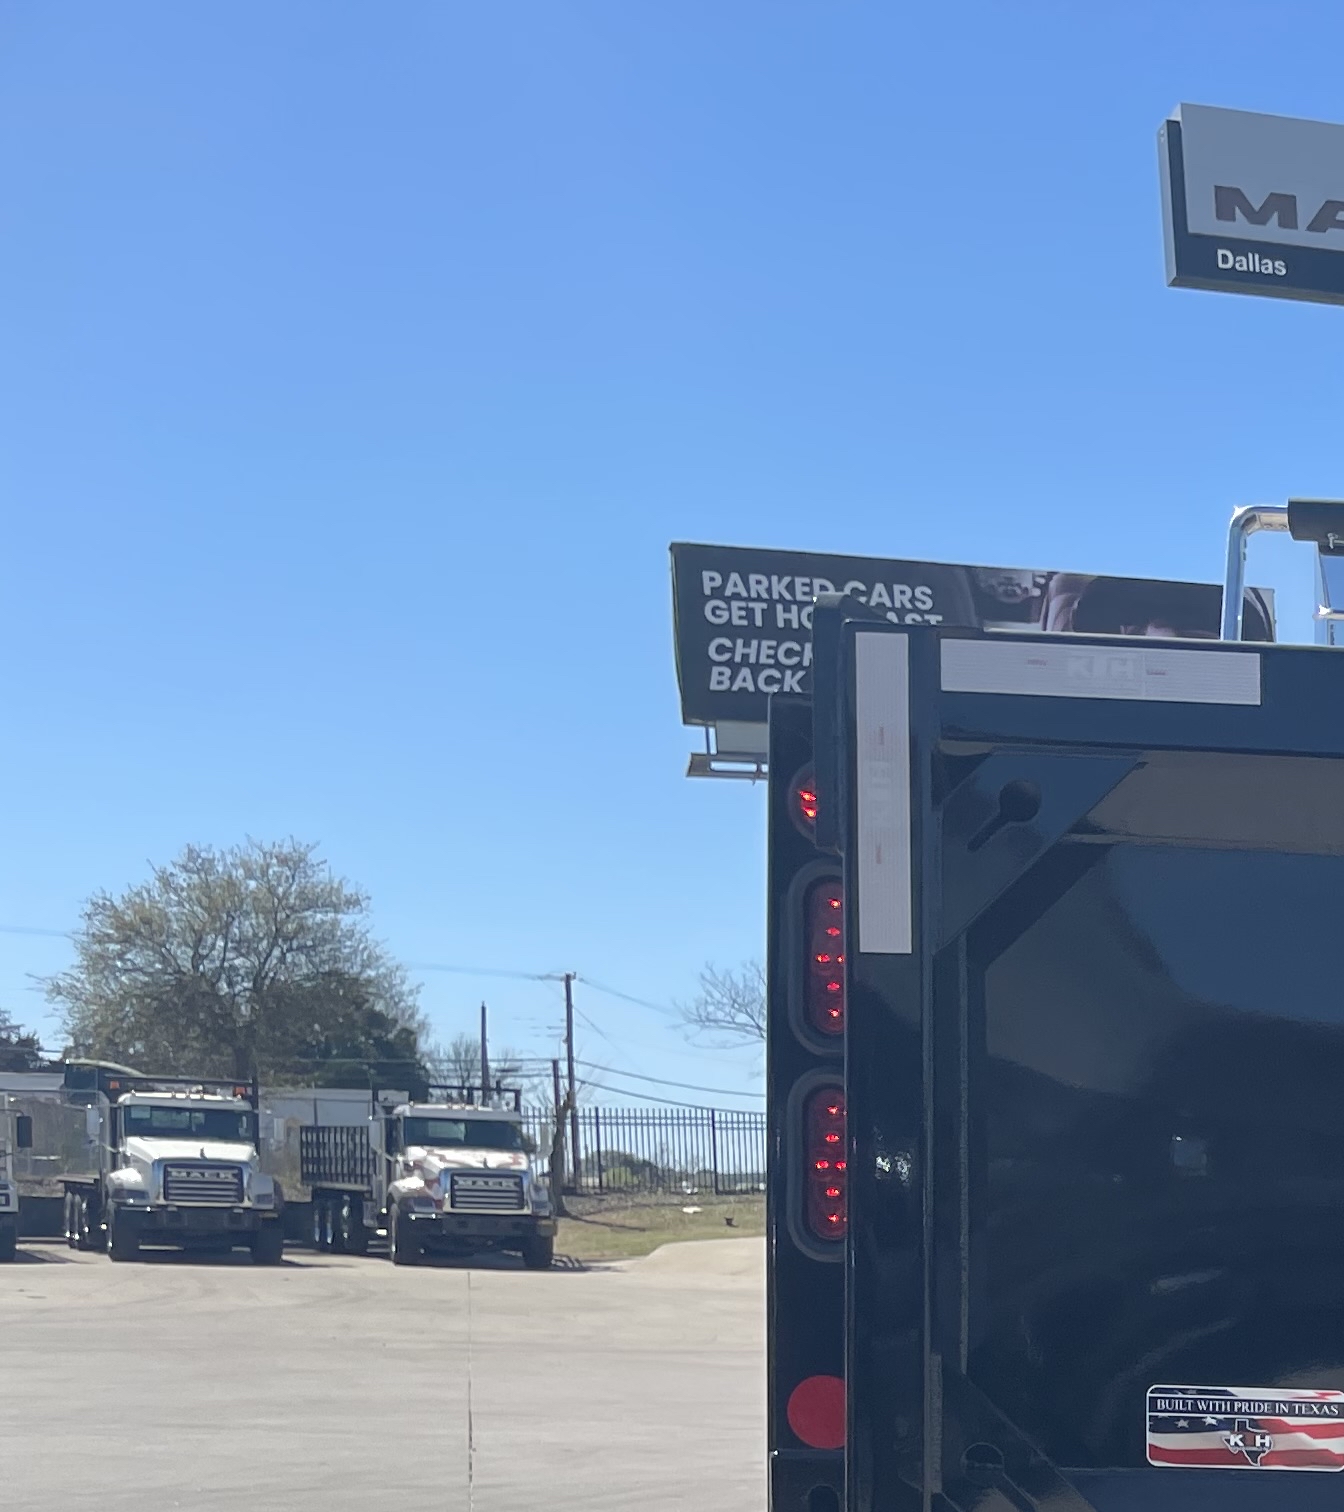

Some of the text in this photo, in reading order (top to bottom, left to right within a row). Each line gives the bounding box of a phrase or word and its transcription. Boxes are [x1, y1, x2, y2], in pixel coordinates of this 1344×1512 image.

[1216, 248, 1288, 277] Dallas
[843, 581, 934, 611] CARS
[703, 599, 768, 628] GET
[709, 666, 807, 694] BACK
[1156, 1398, 1339, 1416] BUILT WITH PRIDE IN TEXAS
